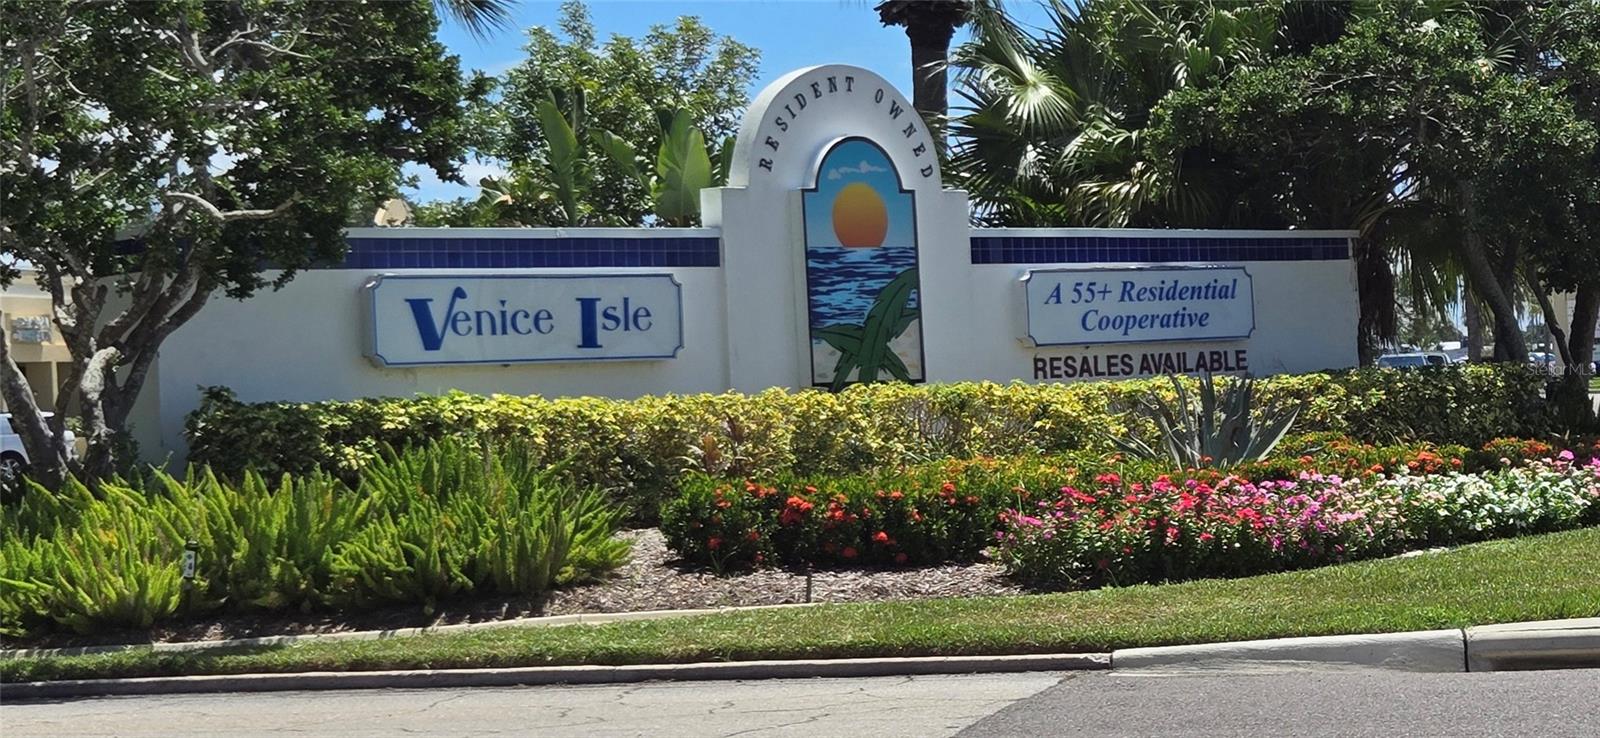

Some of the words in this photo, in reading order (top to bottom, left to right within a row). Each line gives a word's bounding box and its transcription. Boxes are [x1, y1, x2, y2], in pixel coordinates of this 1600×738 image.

[759, 76, 855, 172] RESIDENT
[874, 88, 934, 178] OWNED
[1043, 282, 1063, 305] A
[1071, 281, 1113, 304] 55+
[1117, 278, 1238, 303] Residential
[404, 286, 555, 351] Venice
[575, 297, 653, 348] Isle
[1081, 306, 1210, 336] Cooperative
[1033, 353, 1134, 380] RESALES
[1139, 350, 1249, 375] AVAILABLE
